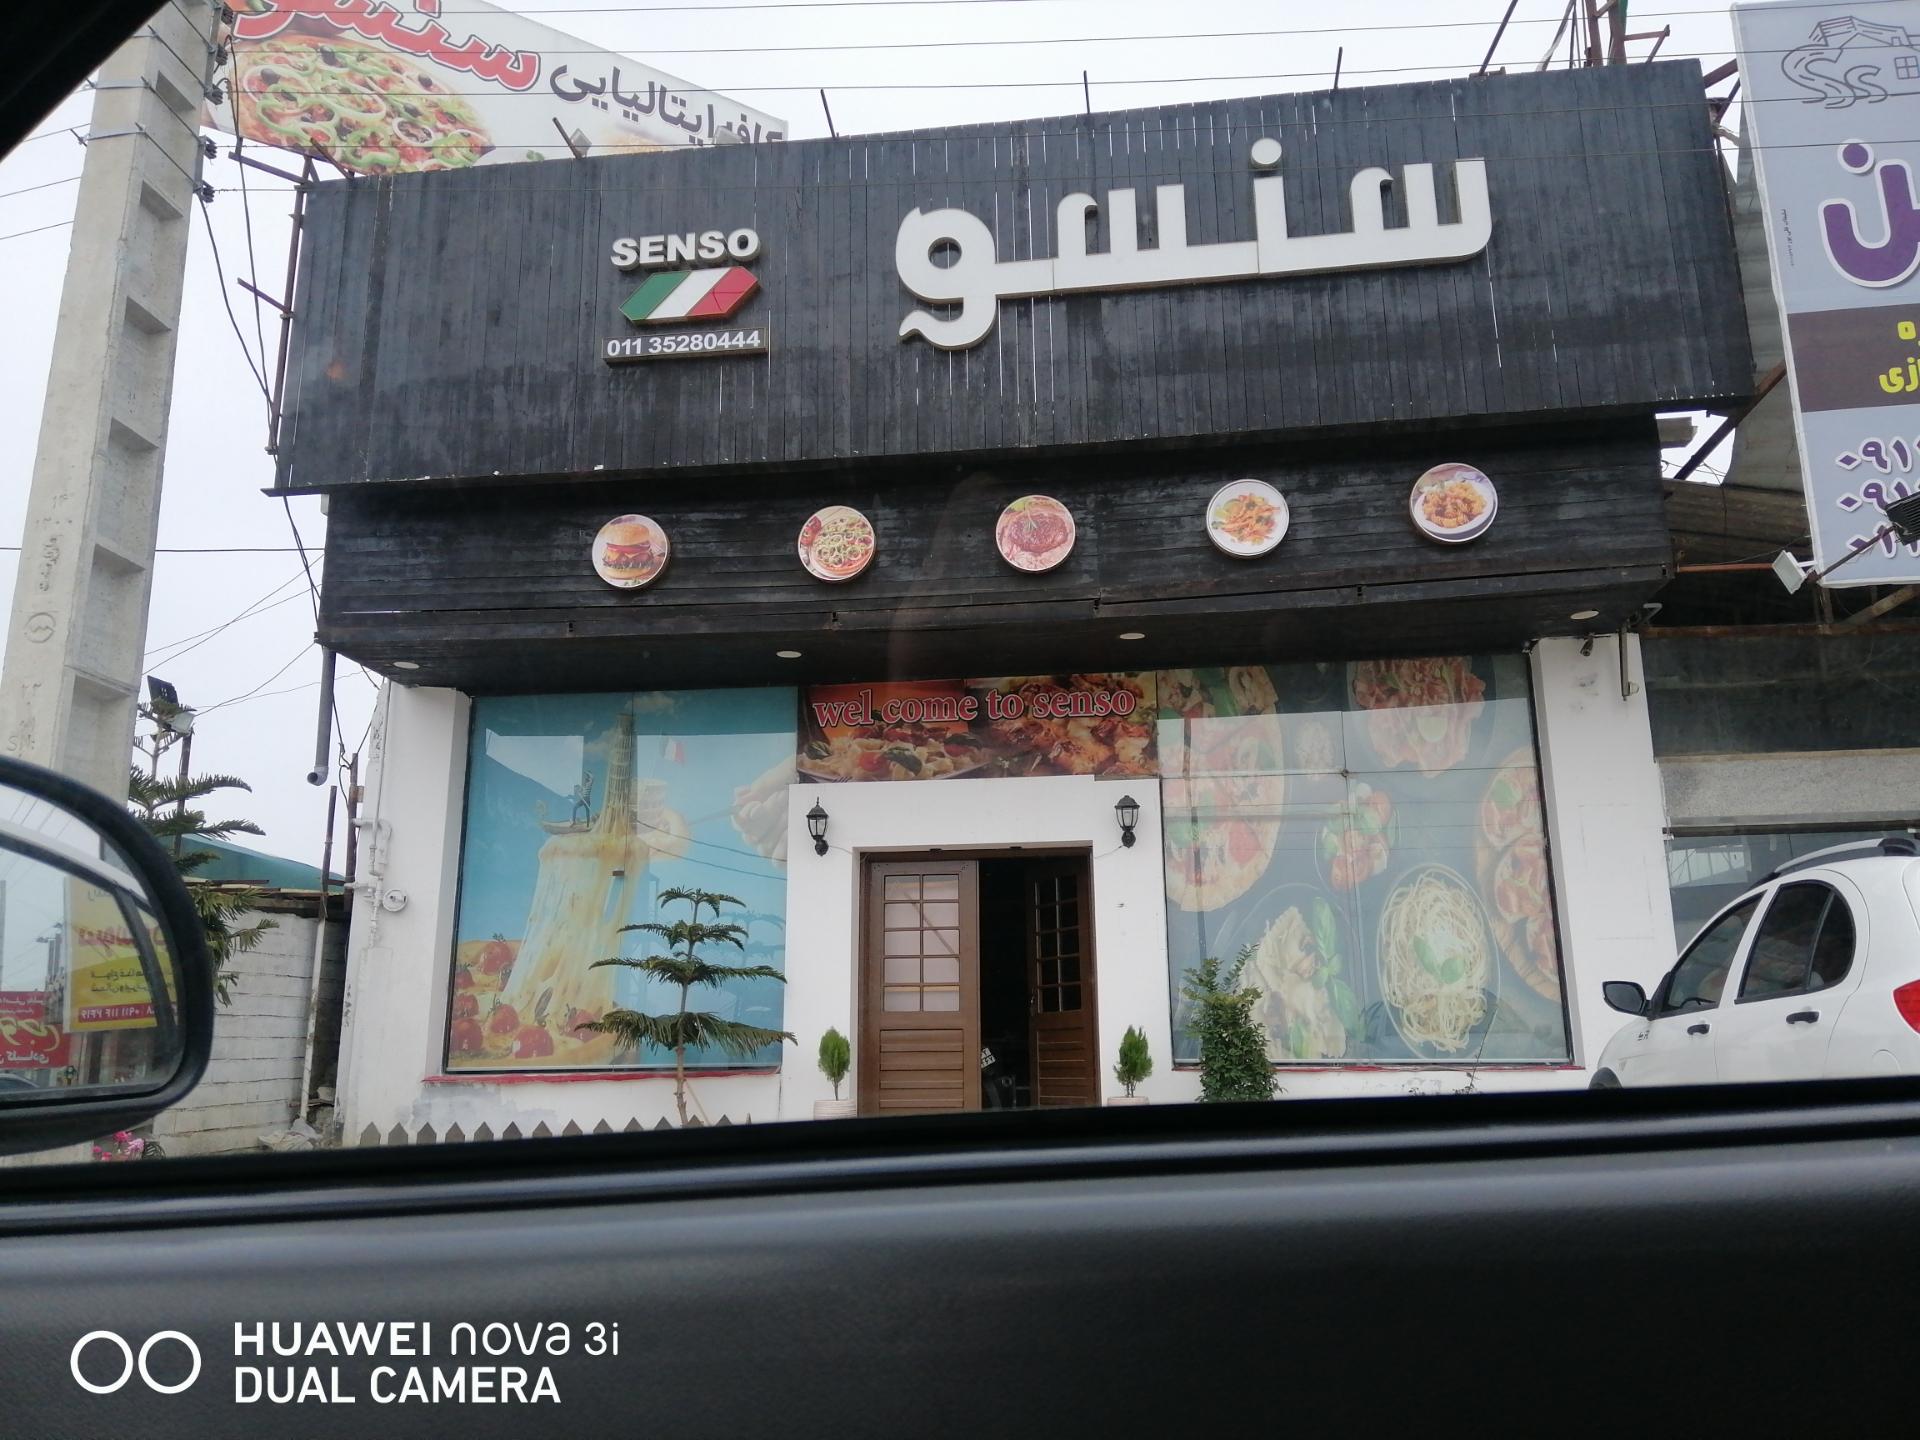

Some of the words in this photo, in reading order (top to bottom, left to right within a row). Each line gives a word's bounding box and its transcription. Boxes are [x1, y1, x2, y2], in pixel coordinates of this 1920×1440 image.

[549, 64, 715, 147] ایتالیایی
[610, 228, 761, 270] SENSO
[896, 137, 1493, 351] سنسو
[607, 338, 642, 357] 011
[648, 329, 761, 354] 35280444
[1836, 436, 1920, 473] ۰۹۱
[1837, 478, 1920, 514] ۰۹۱
[812, 688, 873, 728] wel
[881, 694, 979, 725] come
[986, 688, 1025, 720] to
[1032, 688, 1137, 718] senso
